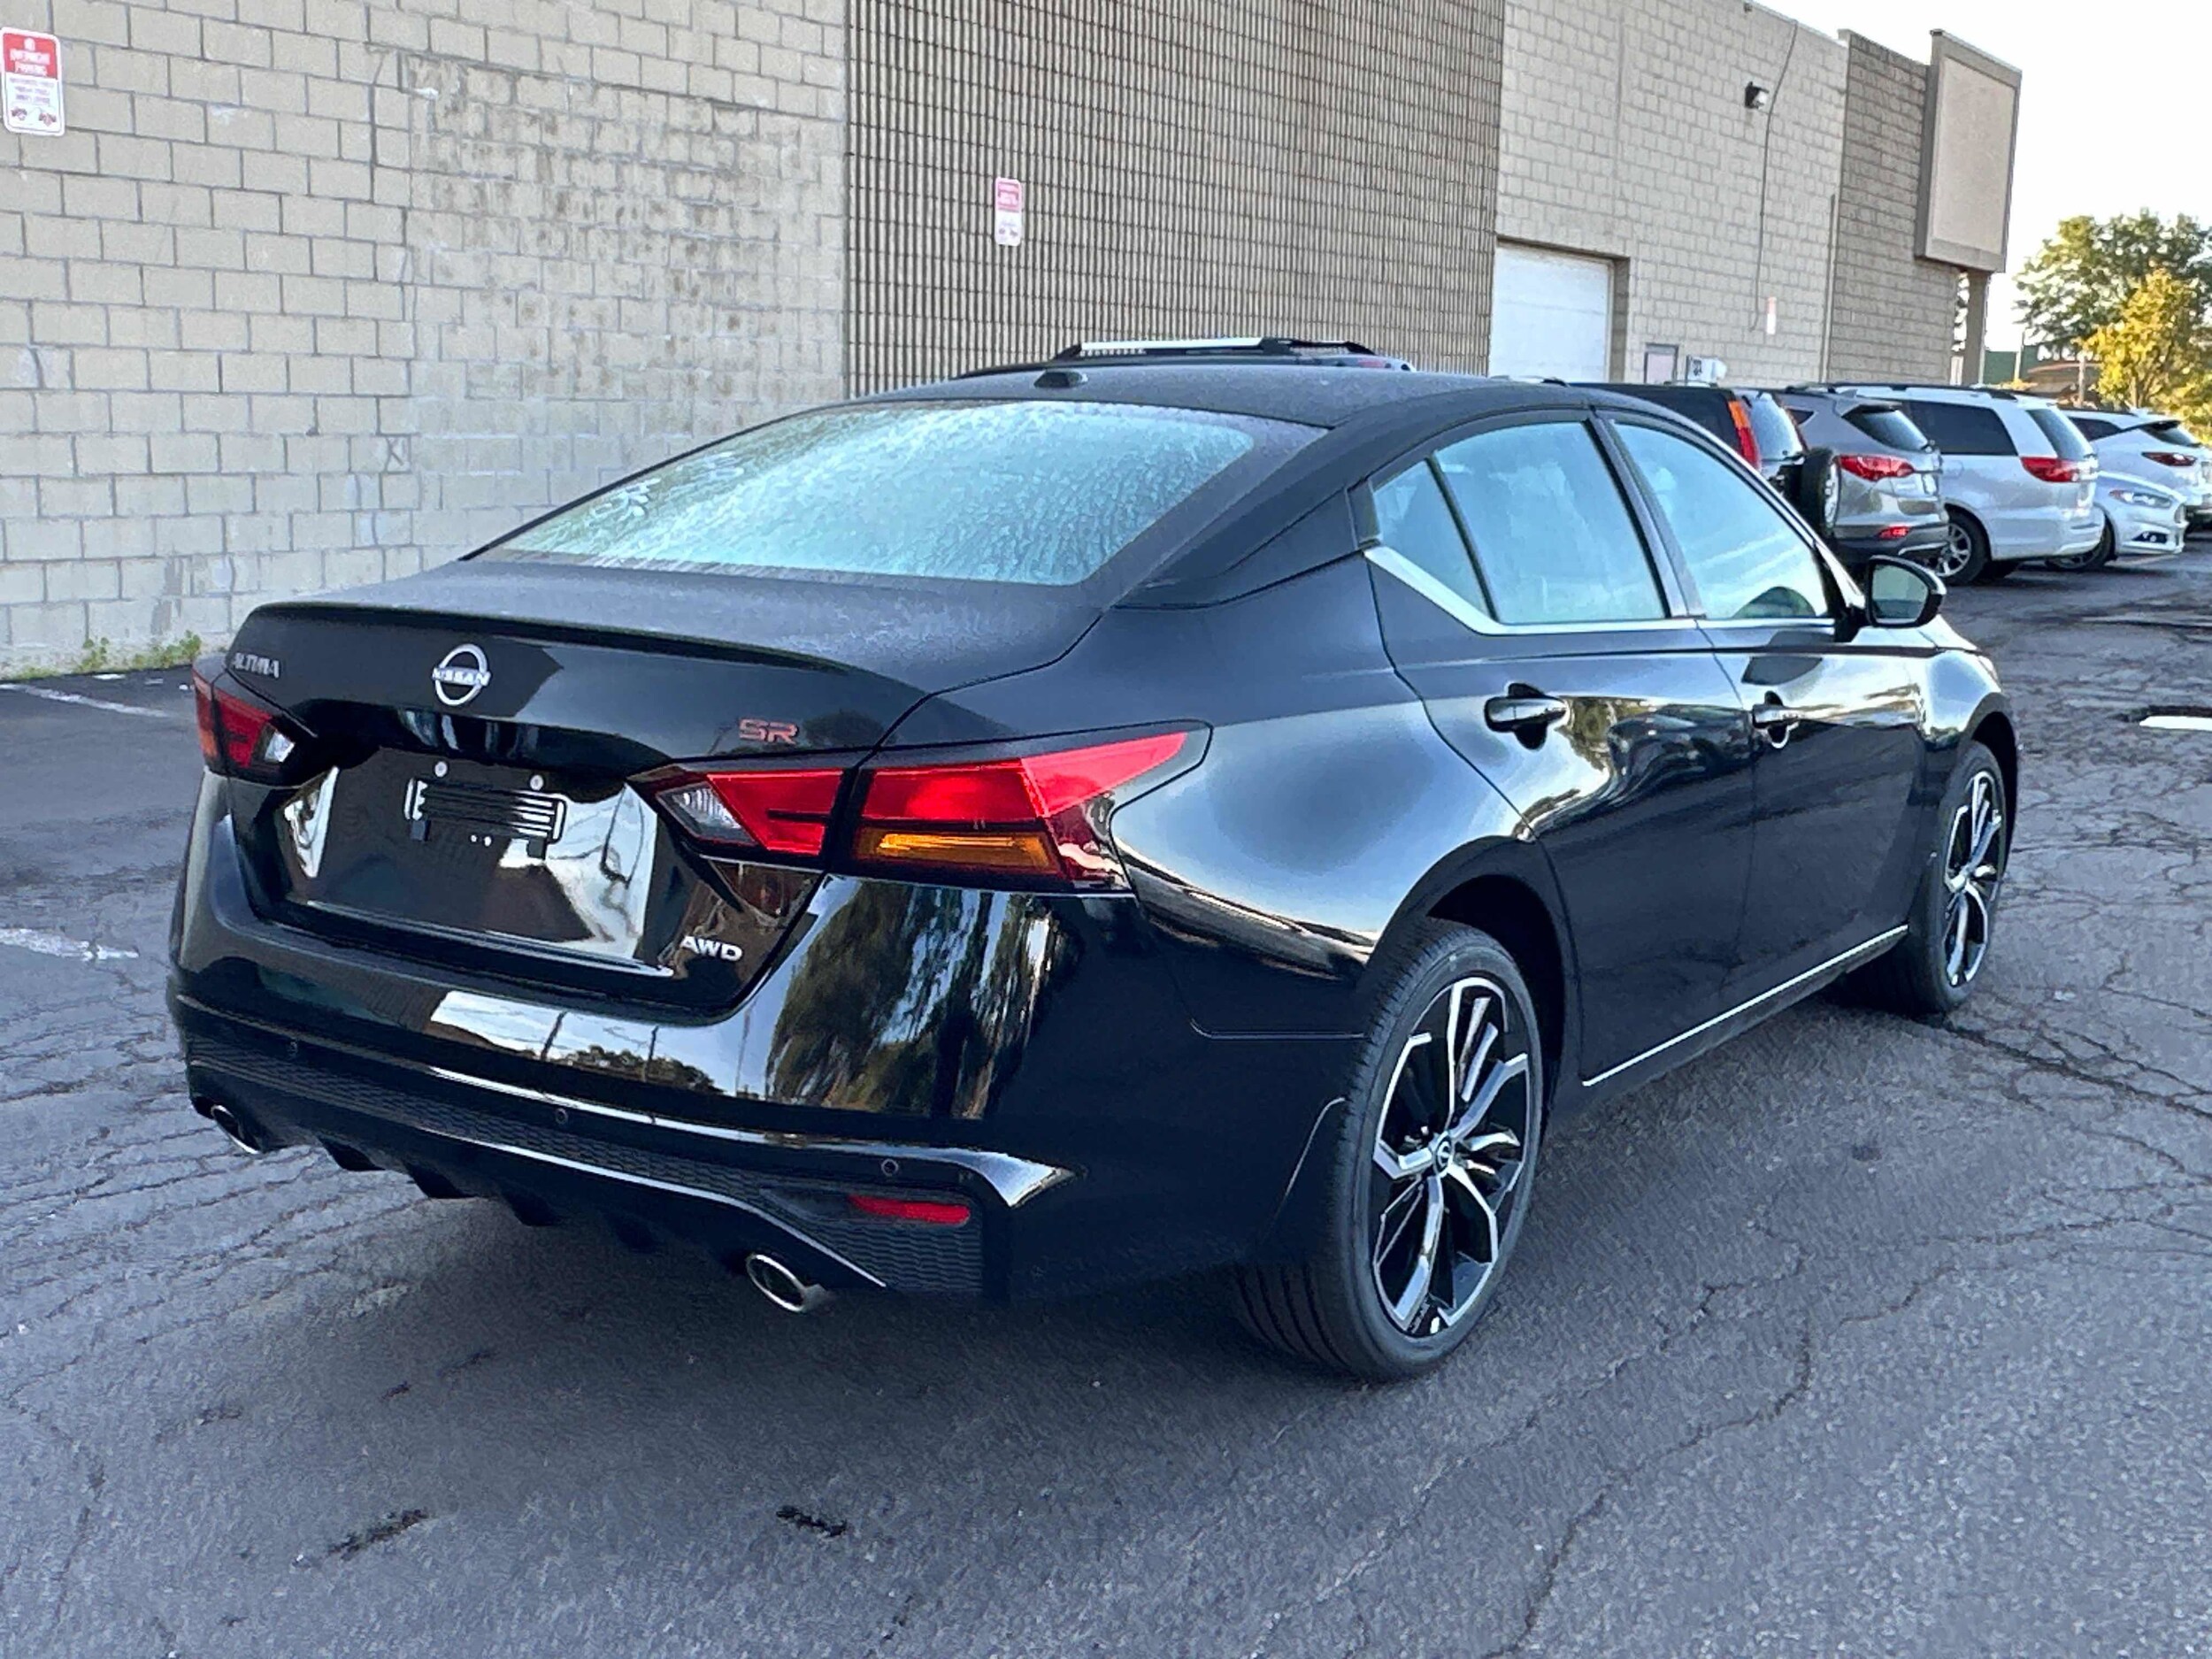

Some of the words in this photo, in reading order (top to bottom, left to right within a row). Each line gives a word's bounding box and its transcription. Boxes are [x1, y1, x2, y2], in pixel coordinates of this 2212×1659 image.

[231, 652, 280, 679] ALTIMA
[432, 667, 491, 687] NISSAN
[739, 718, 798, 745] SR
[680, 935, 742, 962] AWD
